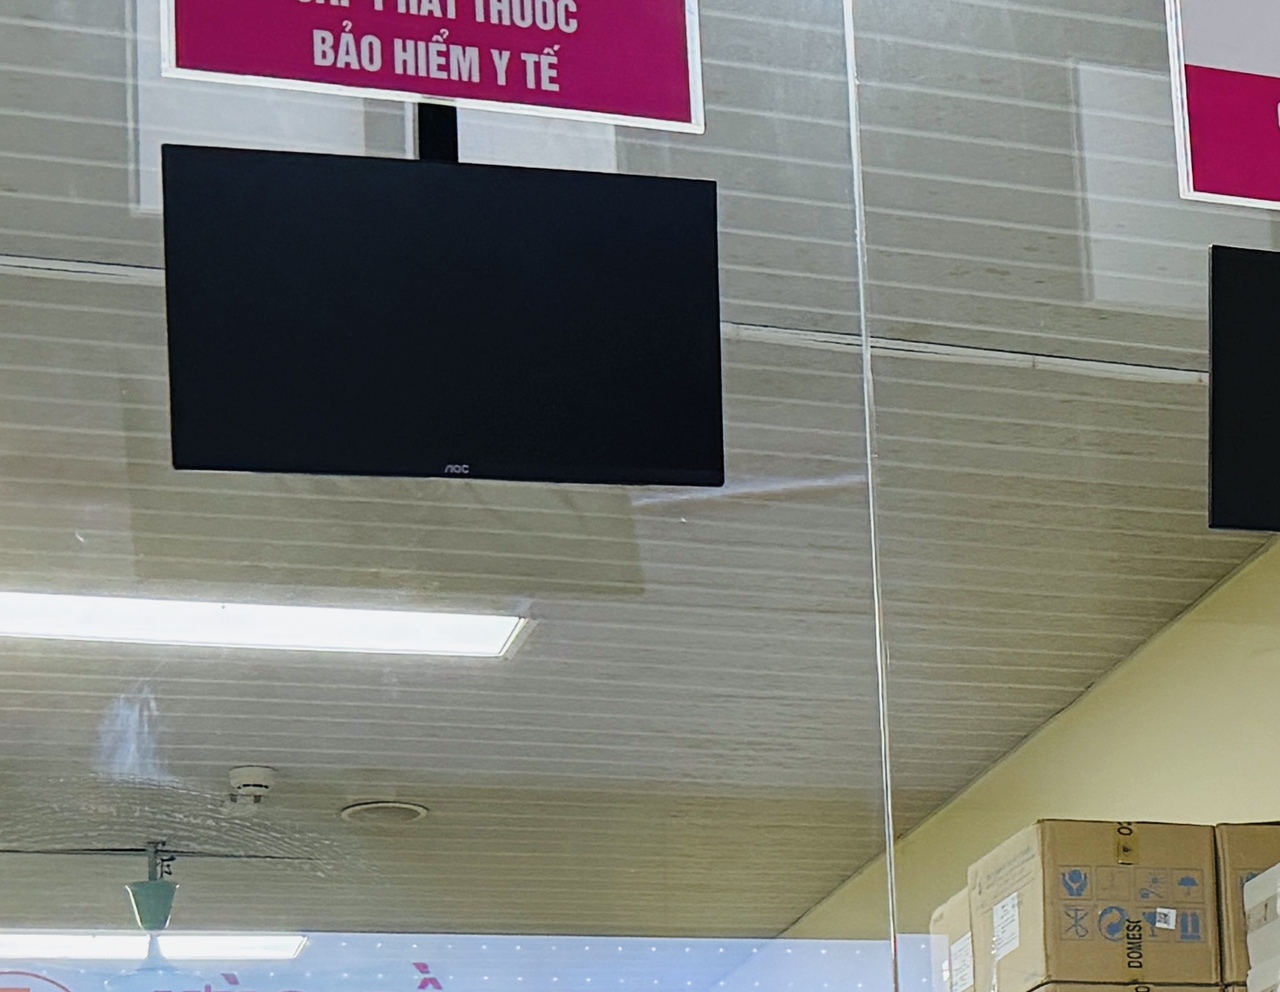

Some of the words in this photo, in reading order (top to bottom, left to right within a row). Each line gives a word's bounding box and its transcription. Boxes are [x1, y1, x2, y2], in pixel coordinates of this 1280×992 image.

[312, 20, 382, 72] BẢO
[393, 28, 480, 83] HIỂM
[490, 48, 511, 86] Y
[520, 44, 560, 92] TẾ
